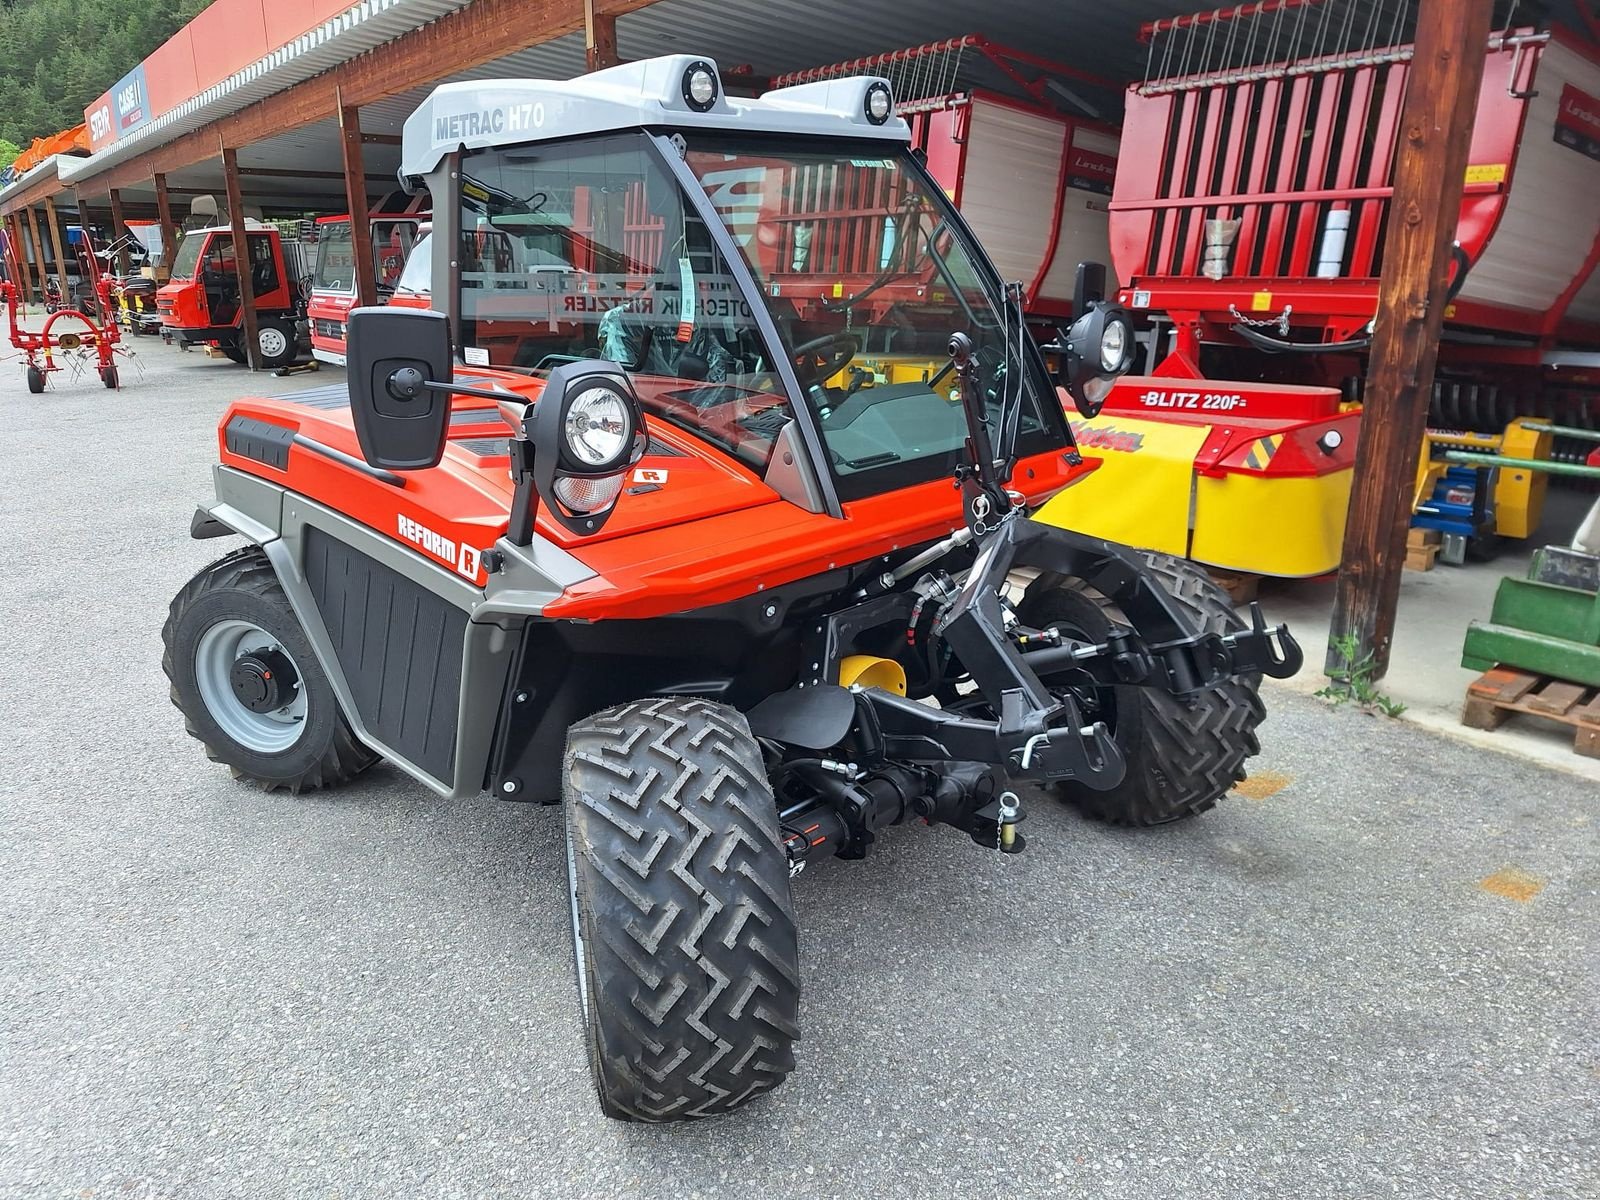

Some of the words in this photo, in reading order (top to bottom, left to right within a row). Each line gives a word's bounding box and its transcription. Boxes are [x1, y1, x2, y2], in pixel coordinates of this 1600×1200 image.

[118, 83, 135, 116] CASE
[89, 105, 112, 142] STEYR
[436, 108, 504, 140] METRAC
[509, 102, 545, 131] H70
[1144, 391, 1200, 409] BLITZ
[1202, 394, 1240, 410] 220F
[397, 512, 456, 565] REFORM
